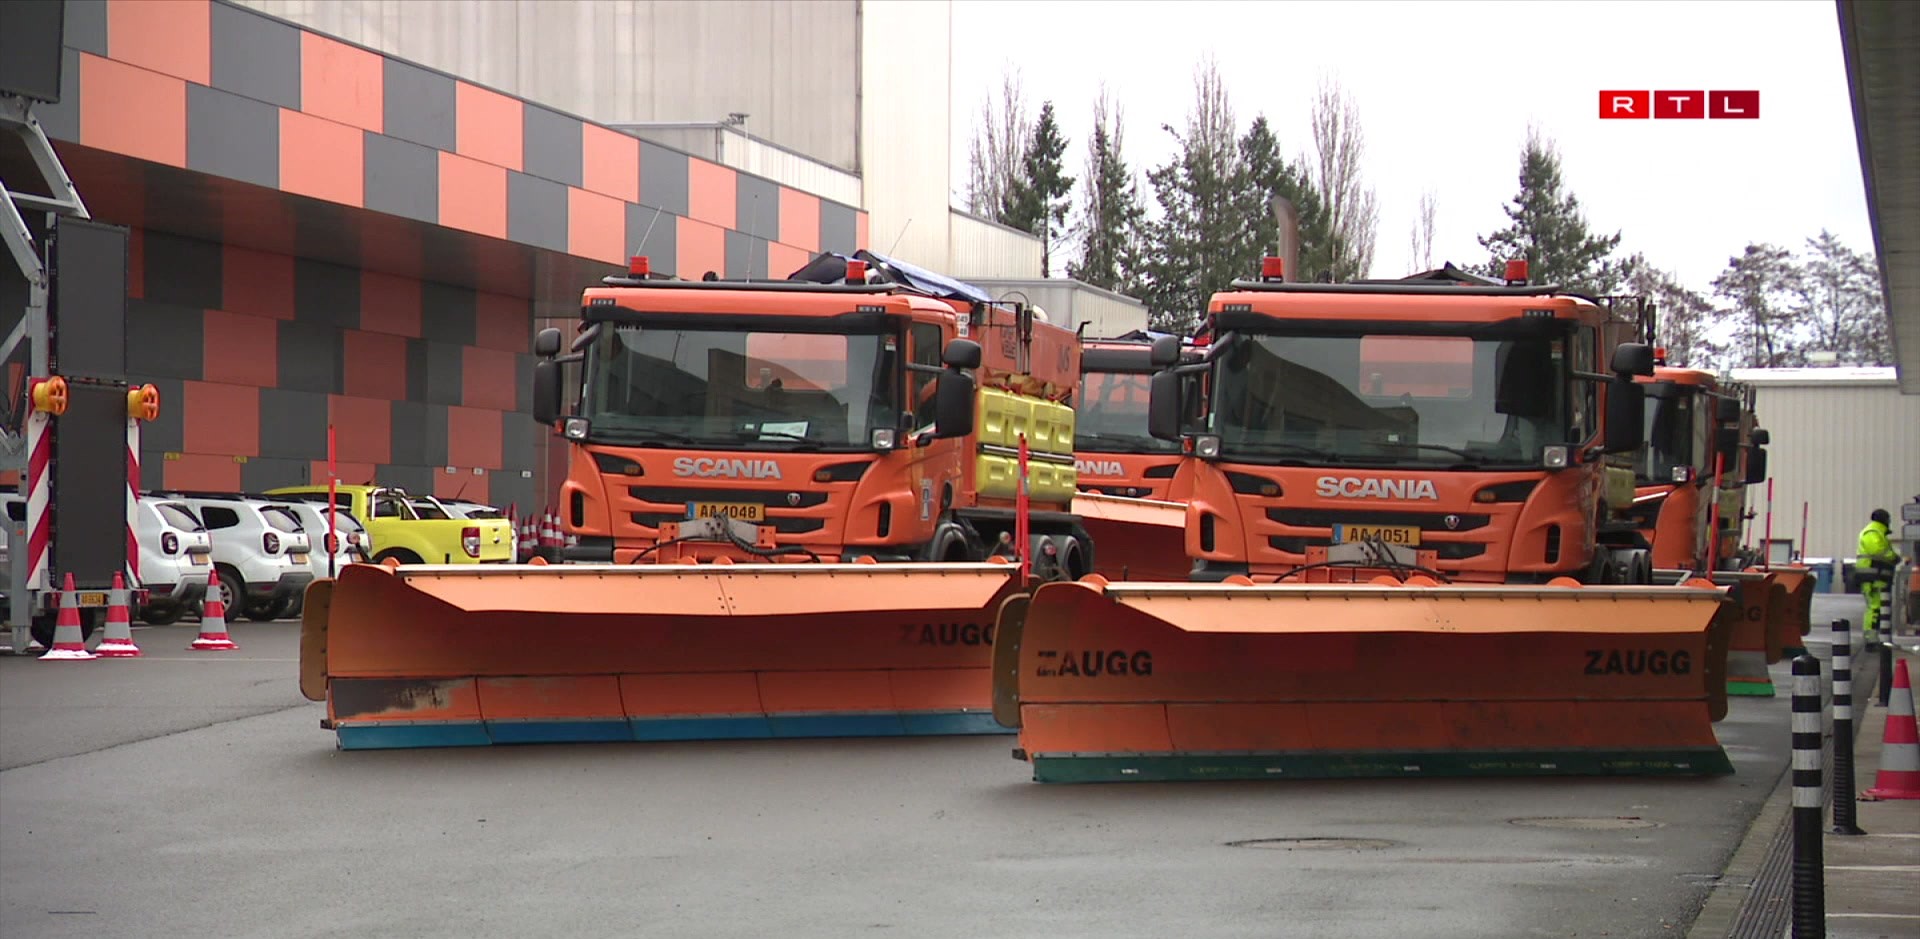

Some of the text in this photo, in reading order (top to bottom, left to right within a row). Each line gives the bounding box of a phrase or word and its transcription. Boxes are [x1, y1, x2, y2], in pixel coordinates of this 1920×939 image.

[672, 457, 782, 479] SCANIA
[1074, 460, 1124, 476] ANIA
[1315, 476, 1438, 500] SCANIA
[1583, 650, 1691, 676] ZAUGG
